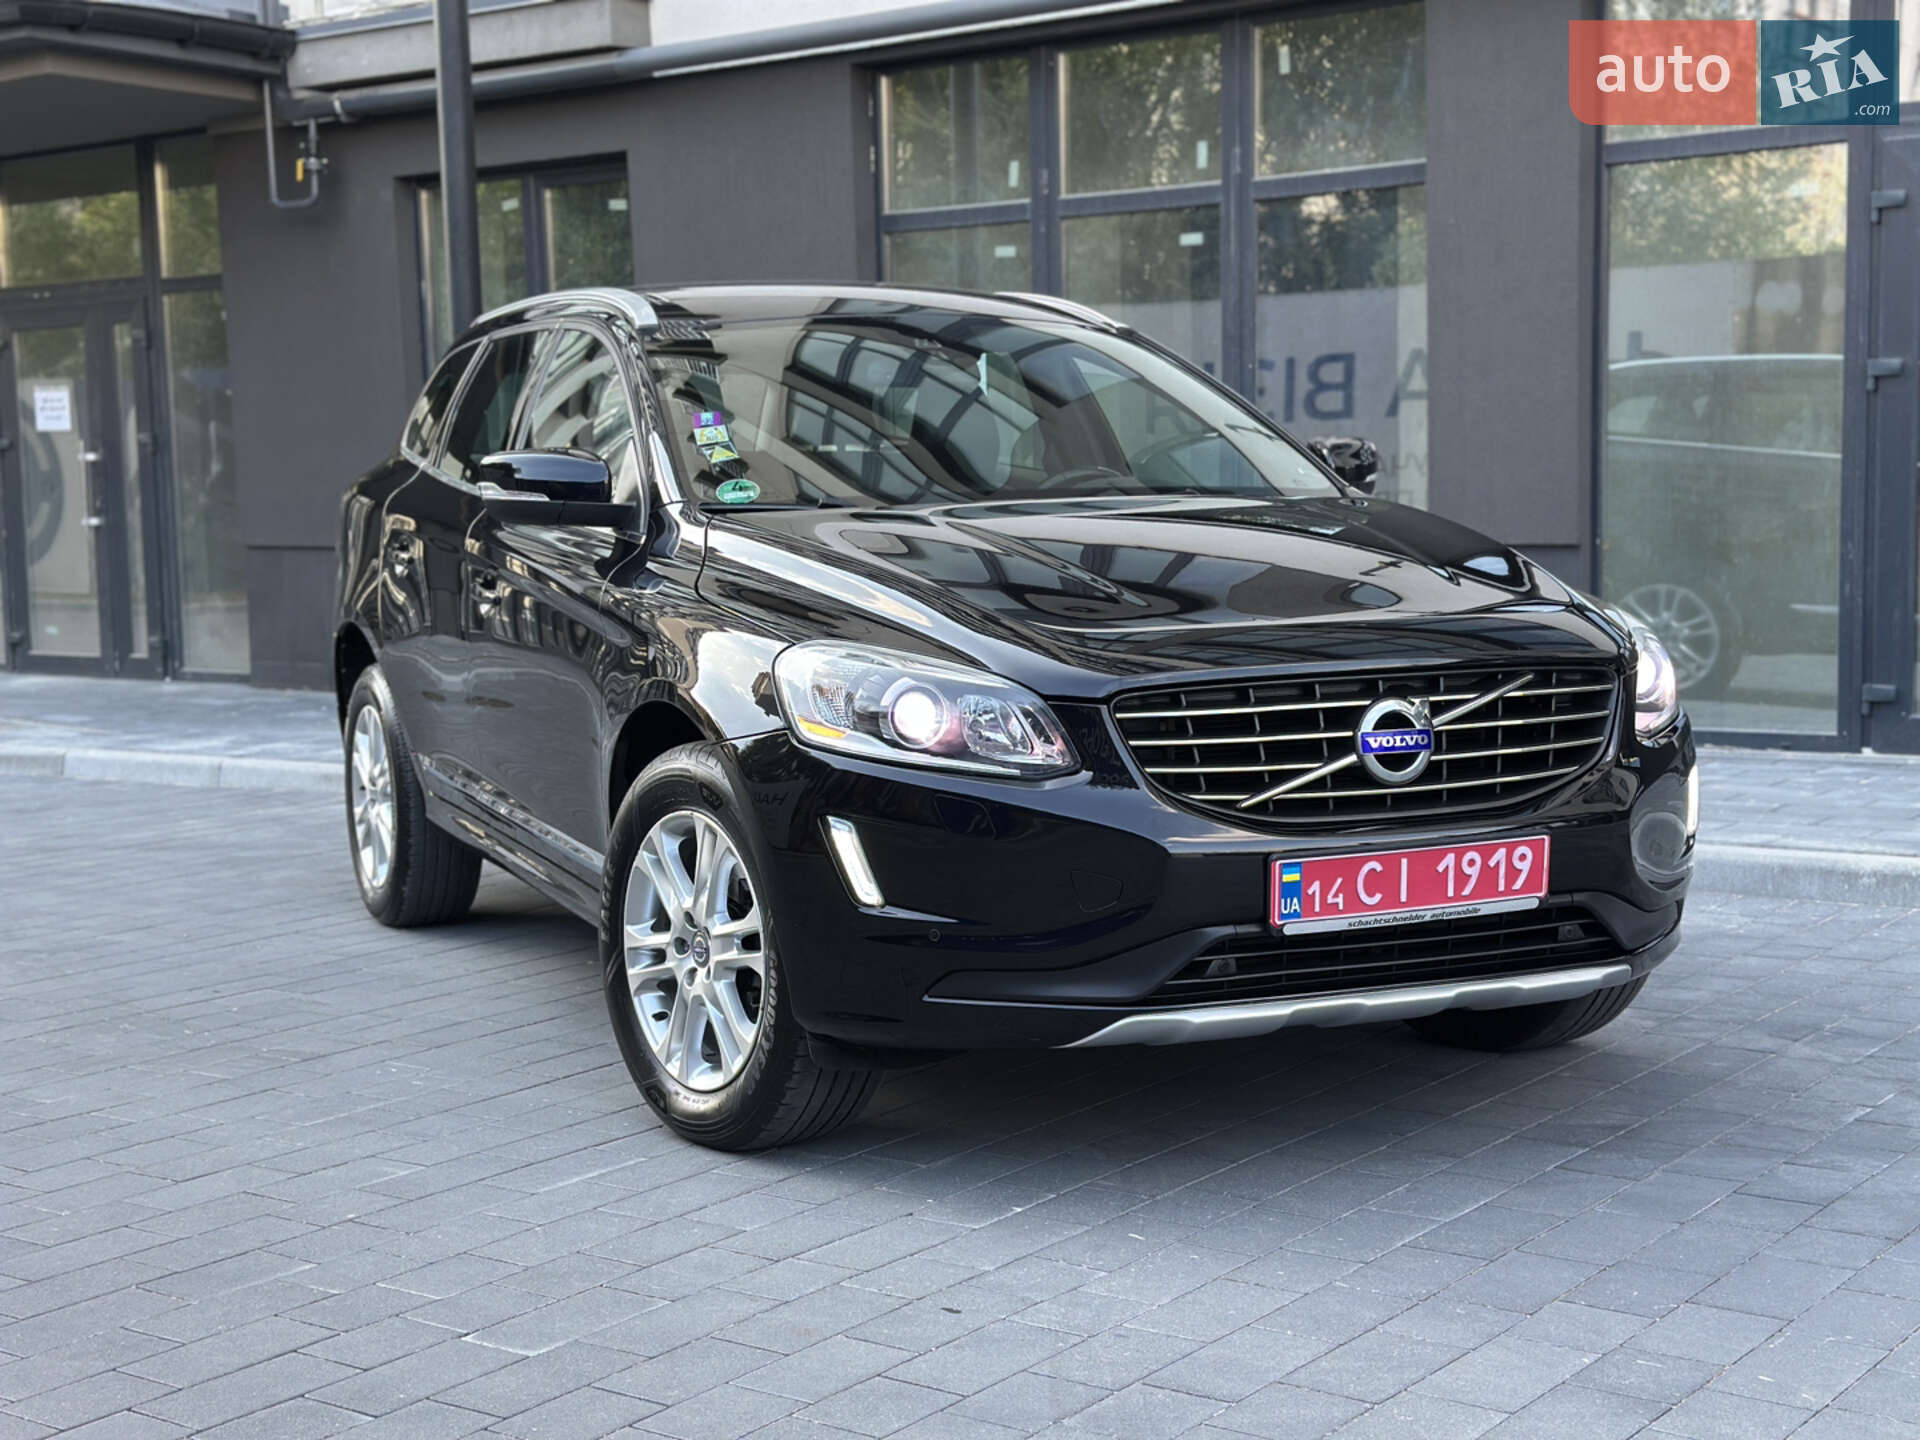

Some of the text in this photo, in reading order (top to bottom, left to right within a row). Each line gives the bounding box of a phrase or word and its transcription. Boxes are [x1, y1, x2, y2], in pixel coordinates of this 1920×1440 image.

[1365, 734, 1429, 749] VOLVO
[1281, 898, 1300, 914] UA
[1307, 878, 1343, 912] 14
[1436, 846, 1533, 897] 1919
[1347, 907, 1481, 928] schachtschneider automobile
